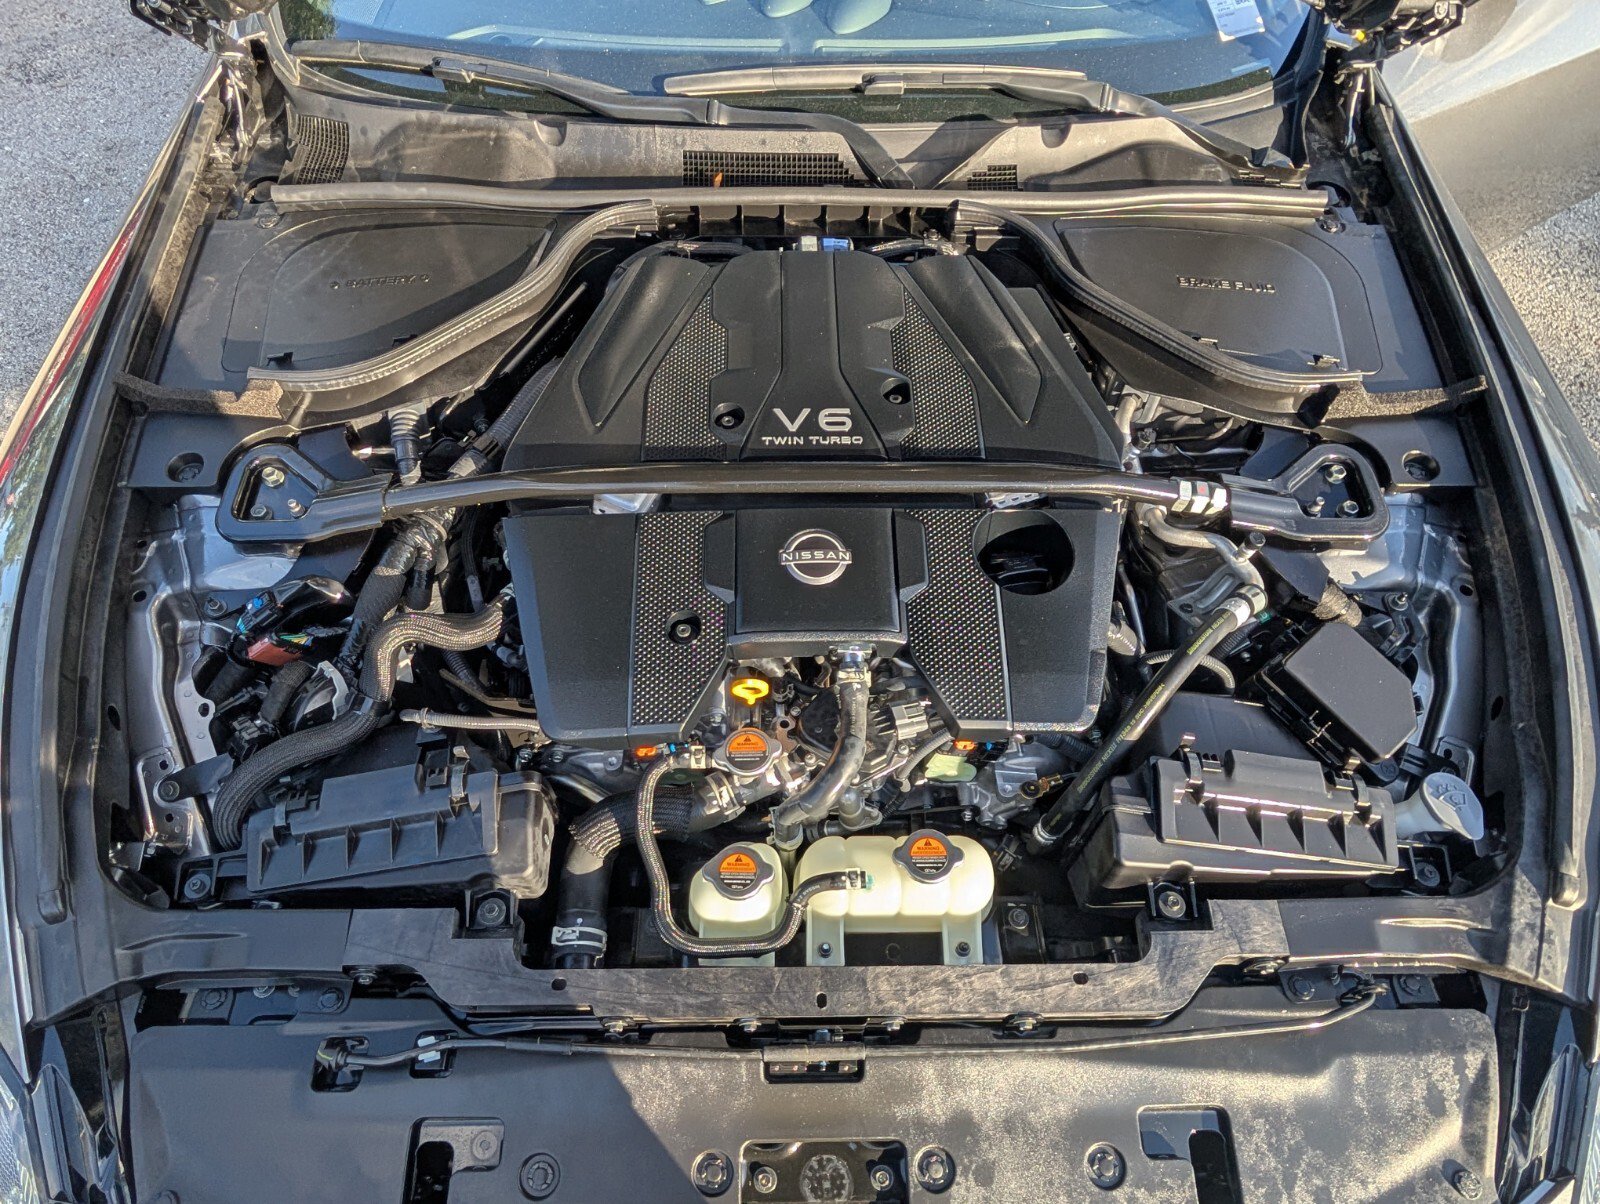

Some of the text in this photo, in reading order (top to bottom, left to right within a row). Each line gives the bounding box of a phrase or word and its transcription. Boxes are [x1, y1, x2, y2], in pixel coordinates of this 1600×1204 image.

[346, 275, 417, 288] BATTERY
[1176, 275, 1276, 293] BRAKE FLUID
[761, 435, 864, 446] TWIN TURBO
[782, 550, 850, 561] NISSAN
